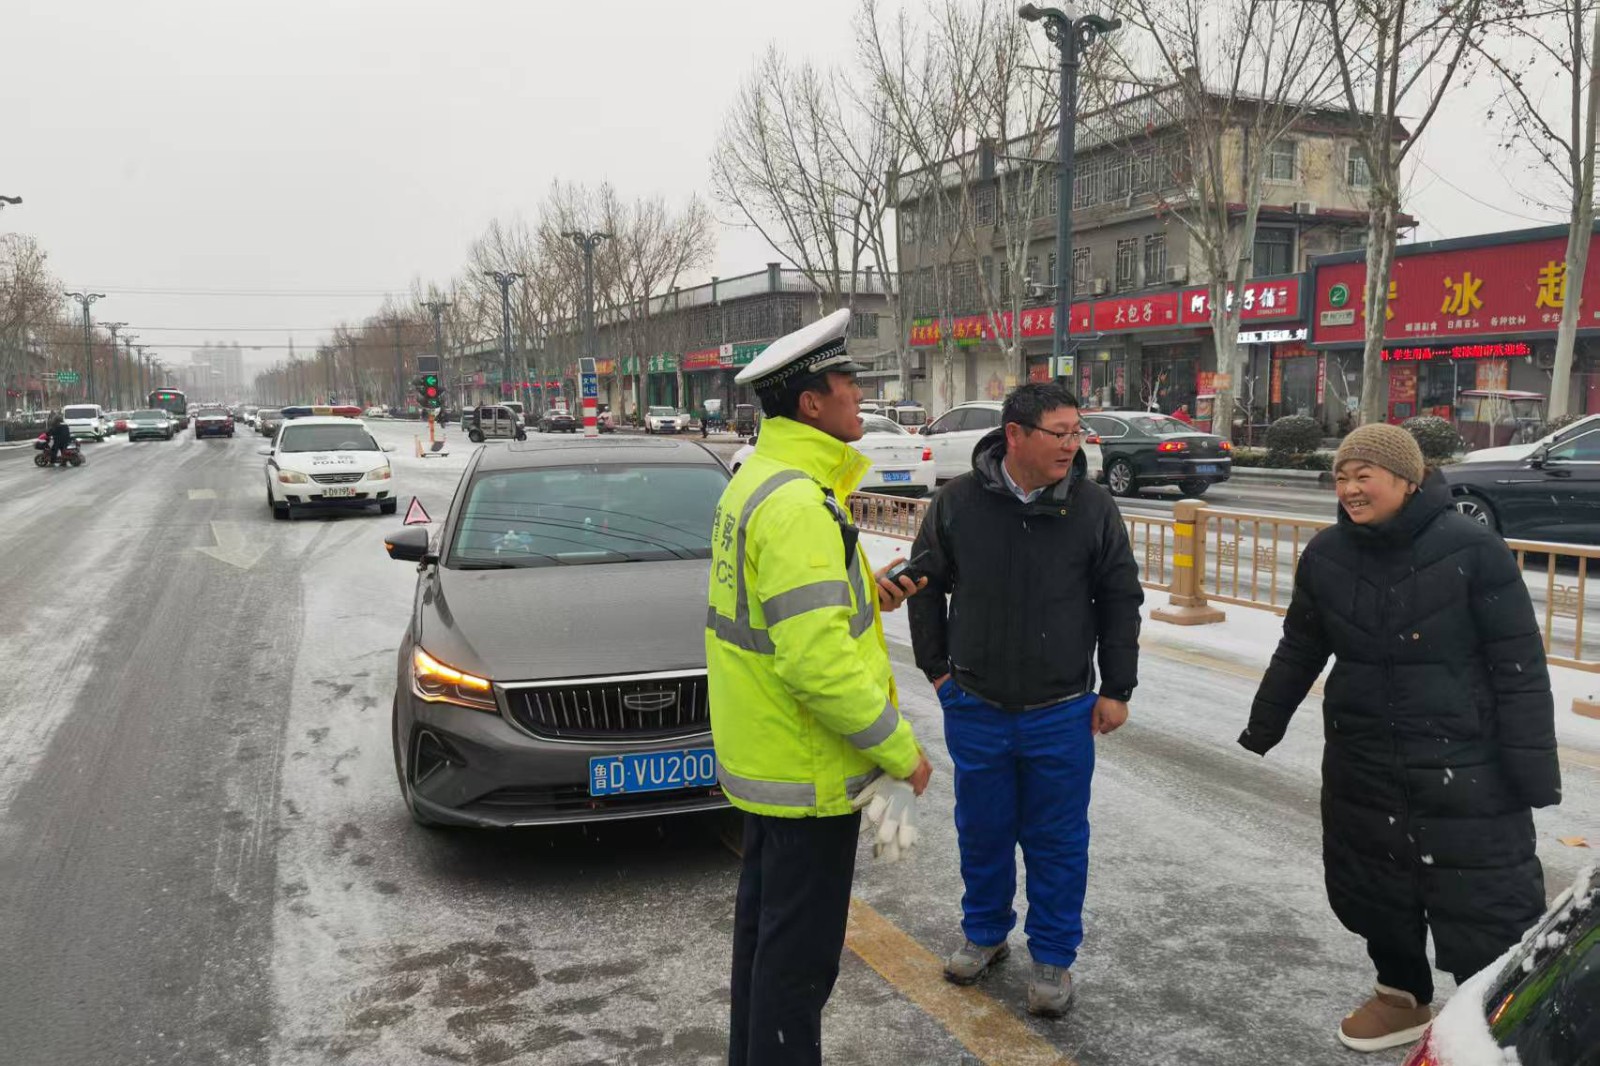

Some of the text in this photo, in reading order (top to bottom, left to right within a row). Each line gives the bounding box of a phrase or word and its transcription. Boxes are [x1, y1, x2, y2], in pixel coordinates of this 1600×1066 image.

[1114, 303, 1153, 324] 大包子
[1490, 315, 1527, 328] 各种饮料
